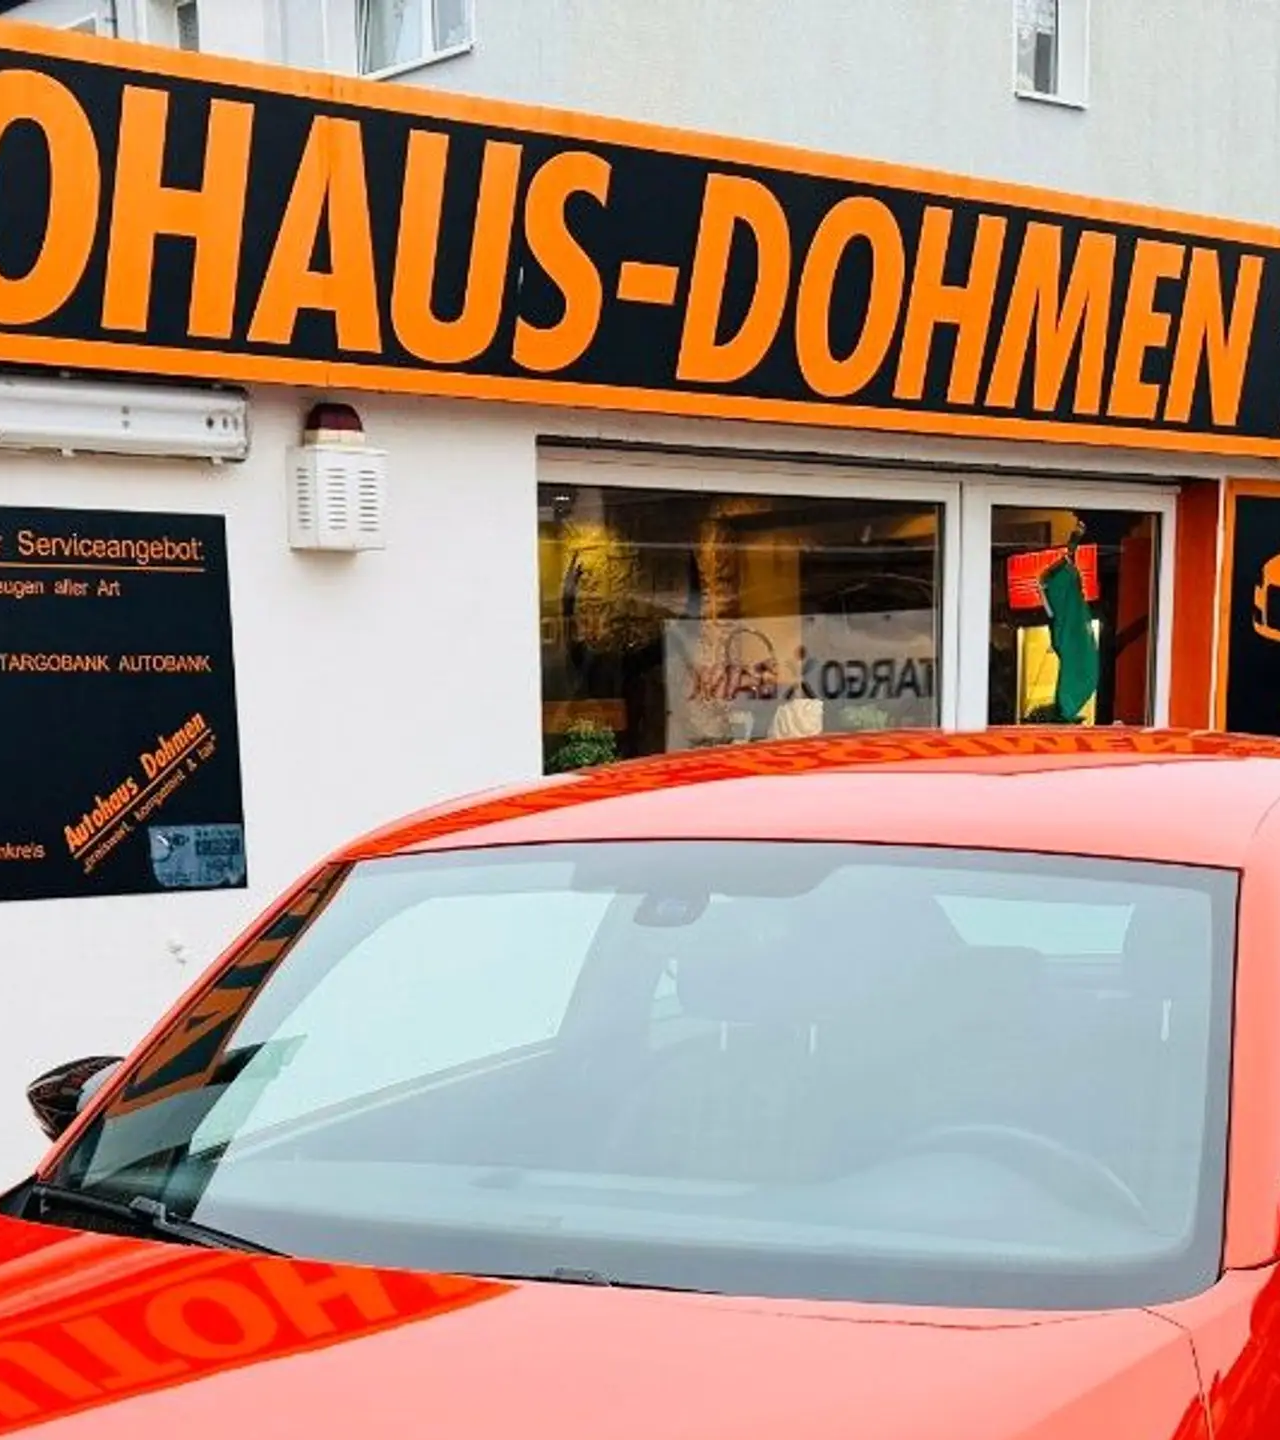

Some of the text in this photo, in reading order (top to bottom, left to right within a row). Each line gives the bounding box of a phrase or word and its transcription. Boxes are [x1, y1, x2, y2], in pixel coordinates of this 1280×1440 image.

[17, 530, 206, 565] Serviceangebot:
[54, 579, 88, 596] aller
[97, 579, 121, 596] Art
[118, 654, 212, 672] AUTOBANK
[63, 712, 207, 852] Autohaus Dohmen
